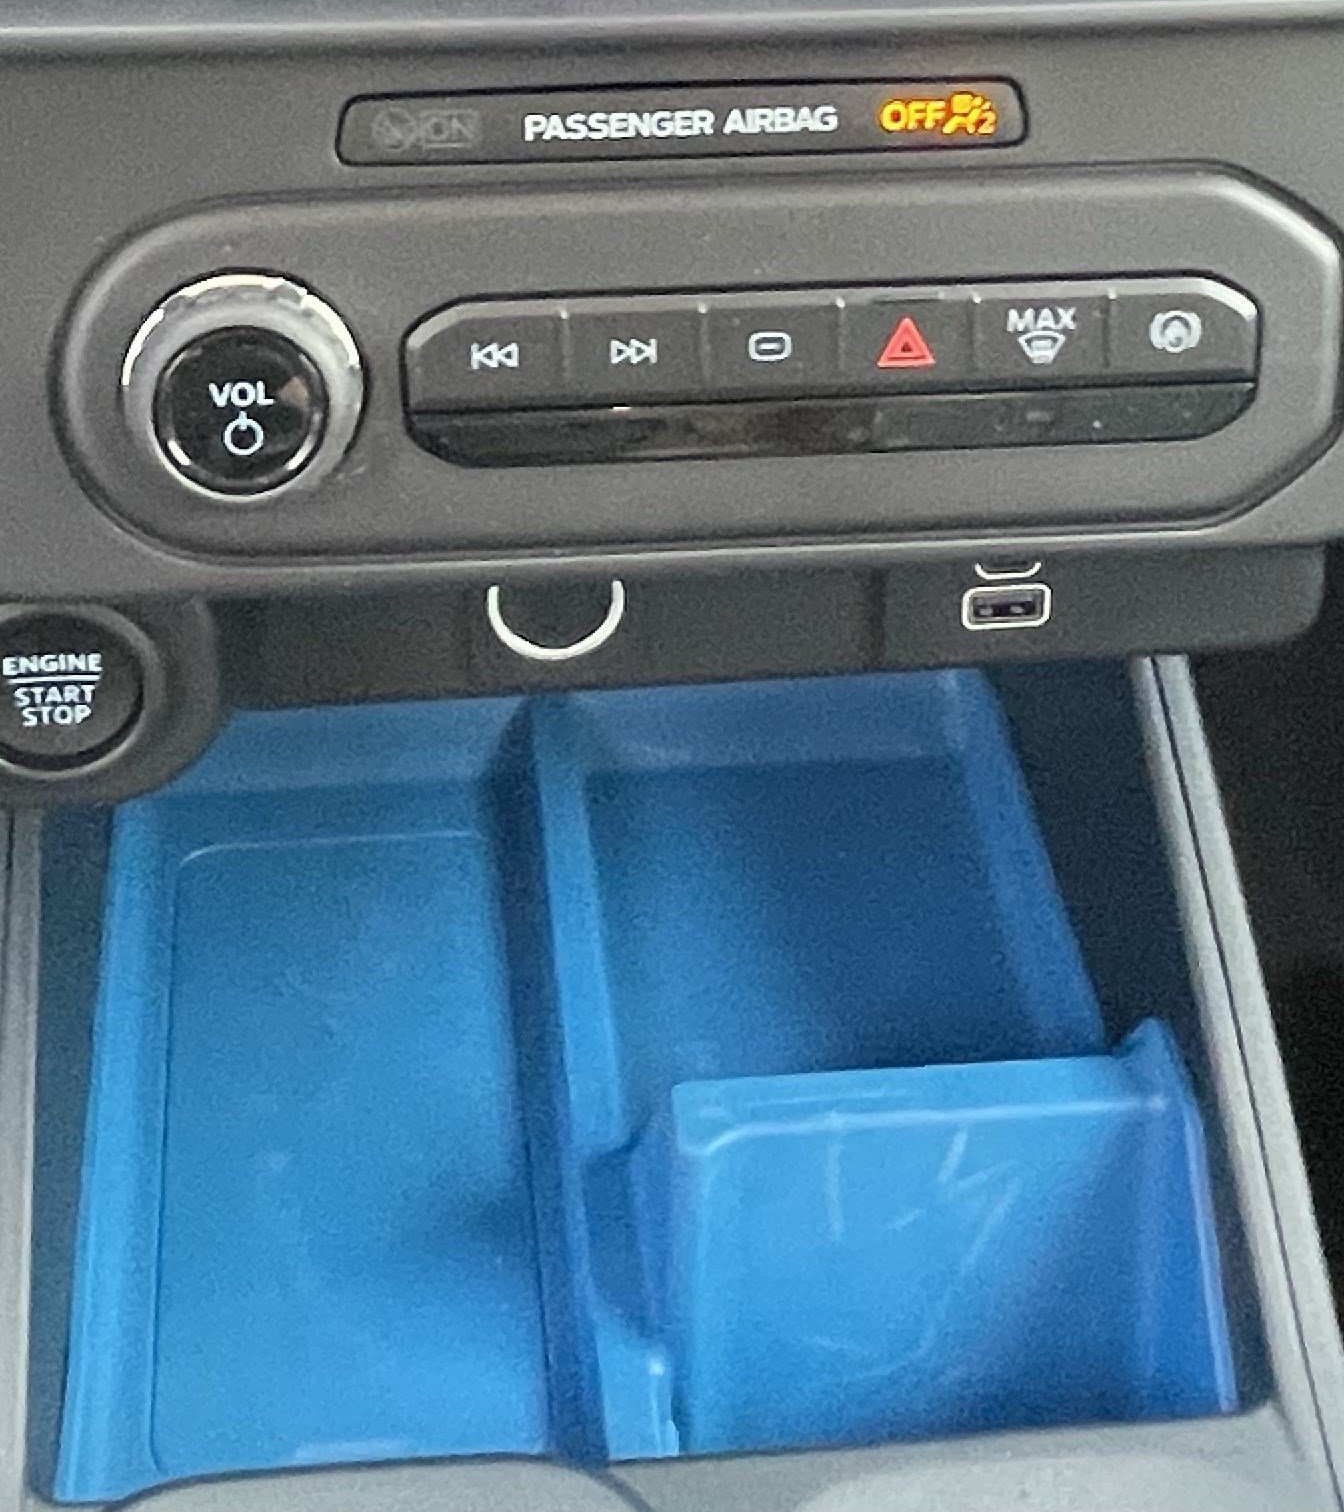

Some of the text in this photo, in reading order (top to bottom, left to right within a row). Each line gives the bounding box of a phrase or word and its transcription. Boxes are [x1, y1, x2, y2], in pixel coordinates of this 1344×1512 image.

[523, 108, 715, 142] PASSENGER
[722, 105, 839, 134] AIRBAG
[880, 99, 946, 131] OFF
[1006, 307, 1077, 333] MAX
[207, 380, 276, 408] VOL
[2, 652, 104, 676] ENGINE
[13, 684, 96, 707] START
[21, 704, 92, 728] STOP
